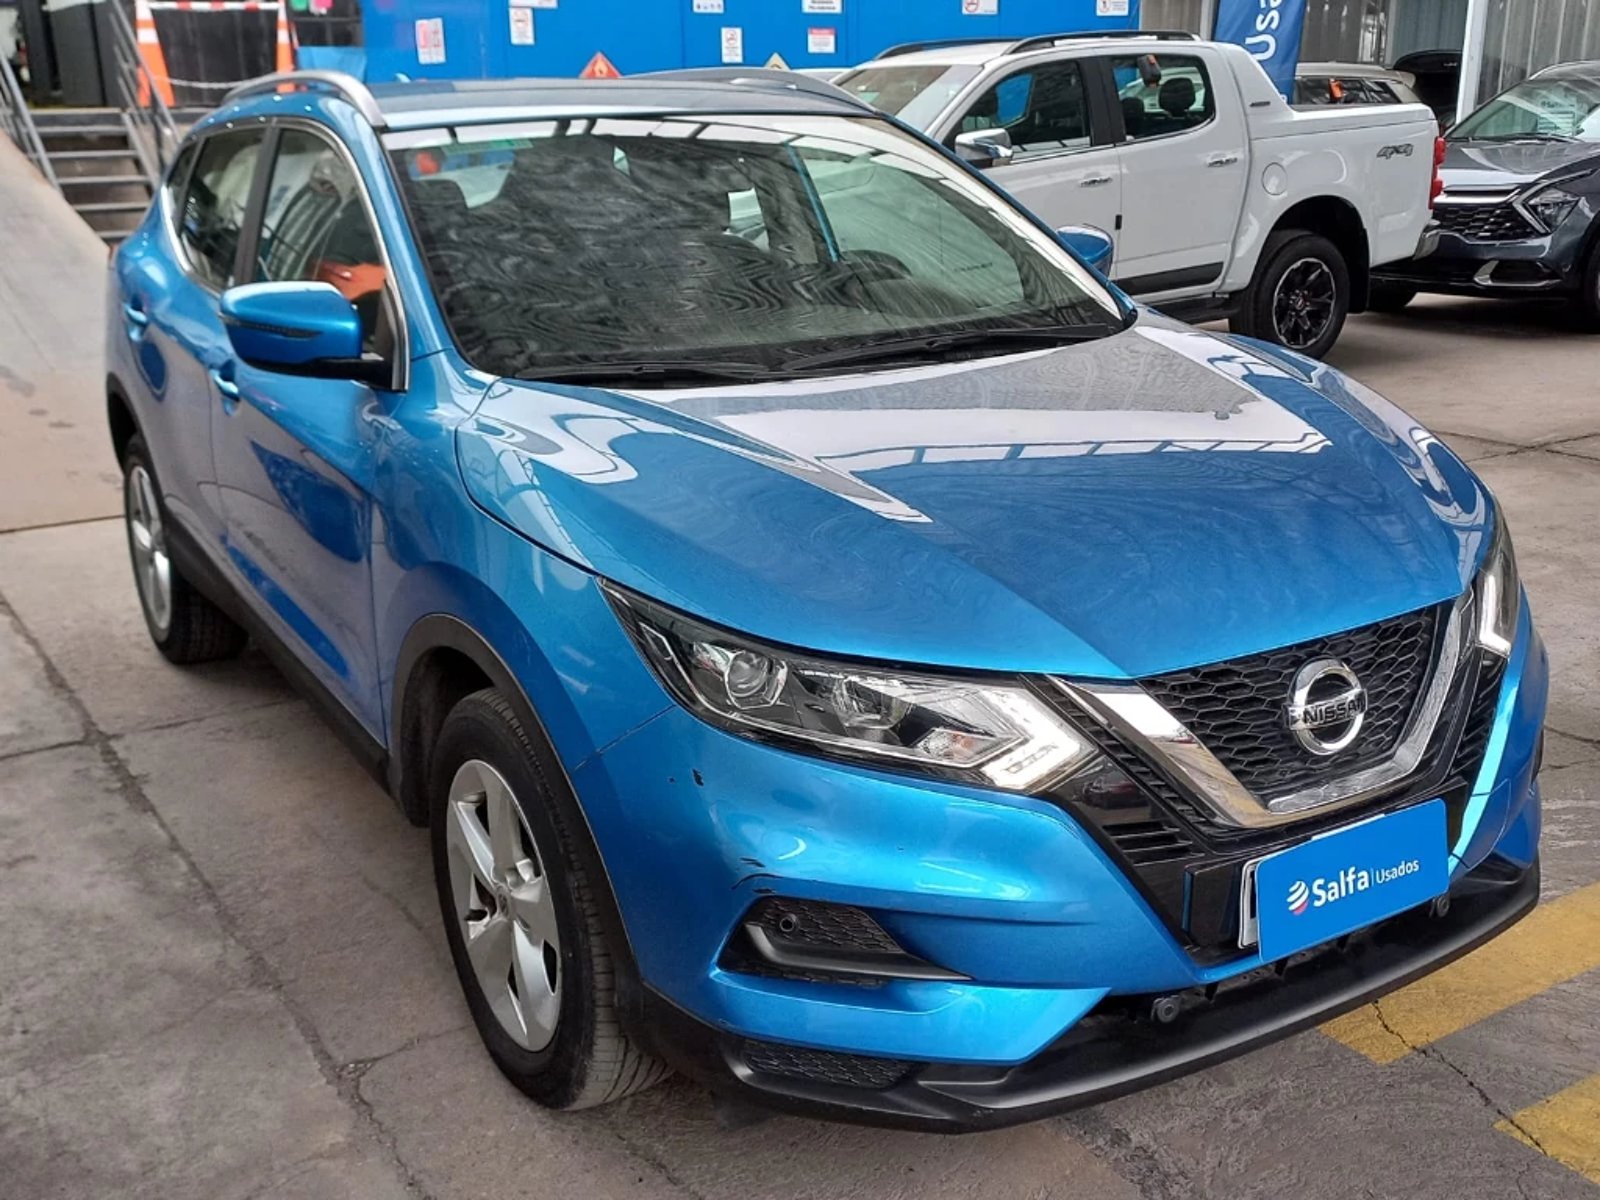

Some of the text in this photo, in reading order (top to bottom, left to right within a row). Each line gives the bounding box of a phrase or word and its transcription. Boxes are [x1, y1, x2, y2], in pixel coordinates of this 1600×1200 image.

[1303, 696, 1365, 723] NISSAN
[1312, 859, 1420, 907] Salfa Usados
